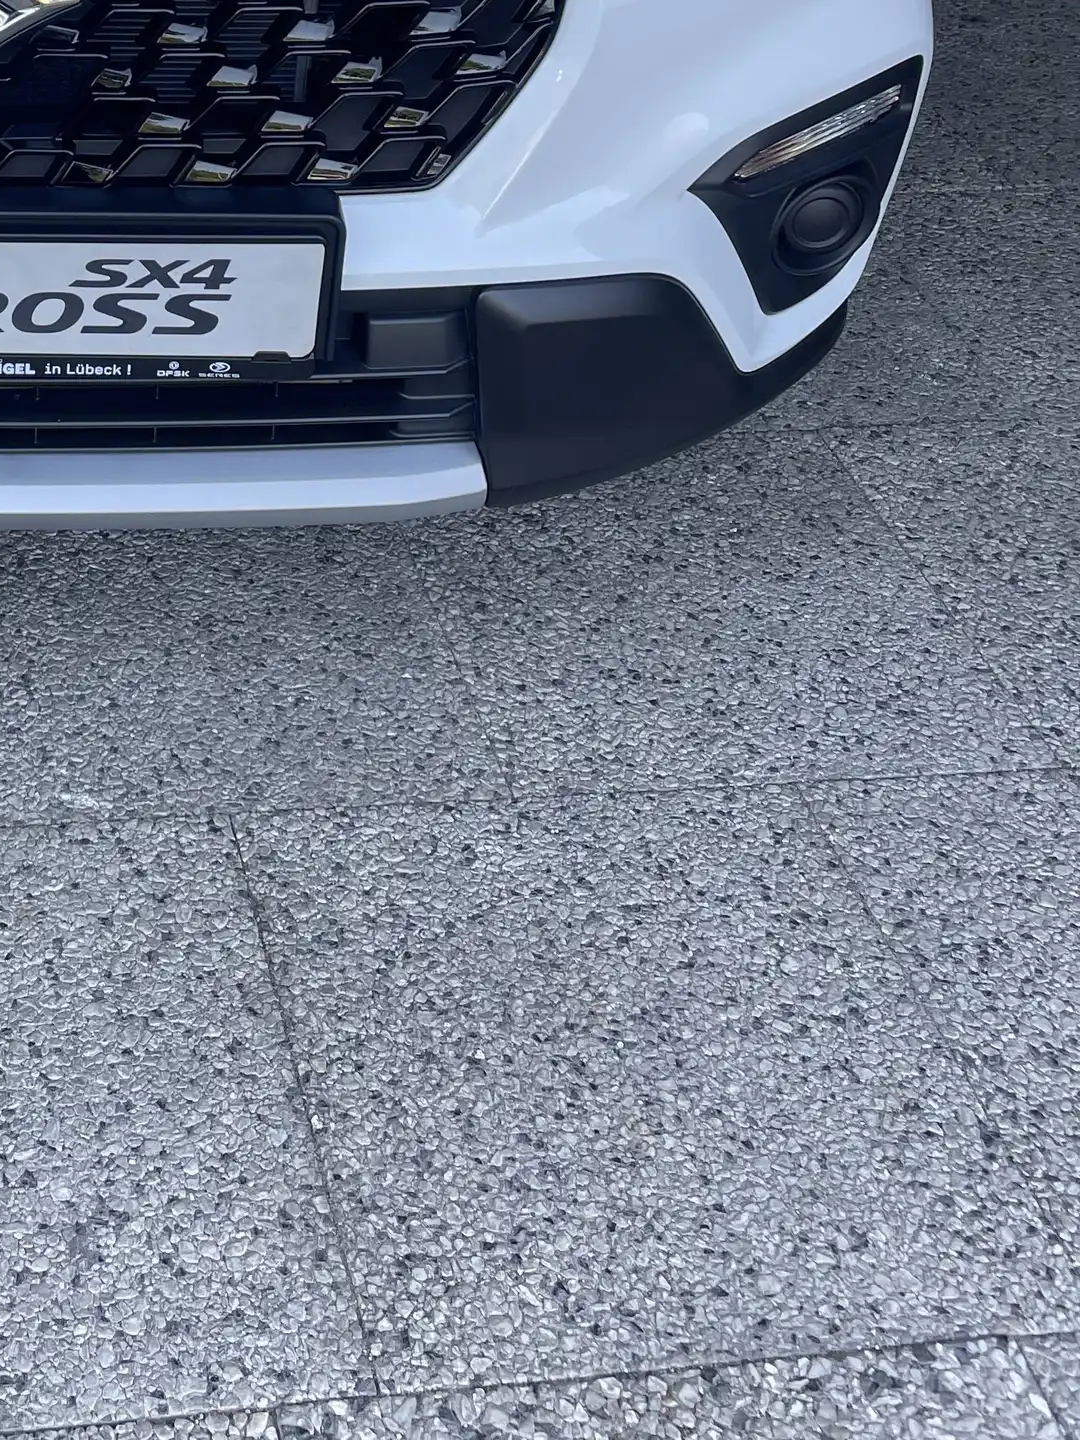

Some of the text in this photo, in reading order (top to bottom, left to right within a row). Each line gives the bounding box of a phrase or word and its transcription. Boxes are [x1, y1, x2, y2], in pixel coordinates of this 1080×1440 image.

[68, 258, 238, 290] SX4
[44, 363, 60, 375] in
[66, 363, 122, 376] Lübeck
